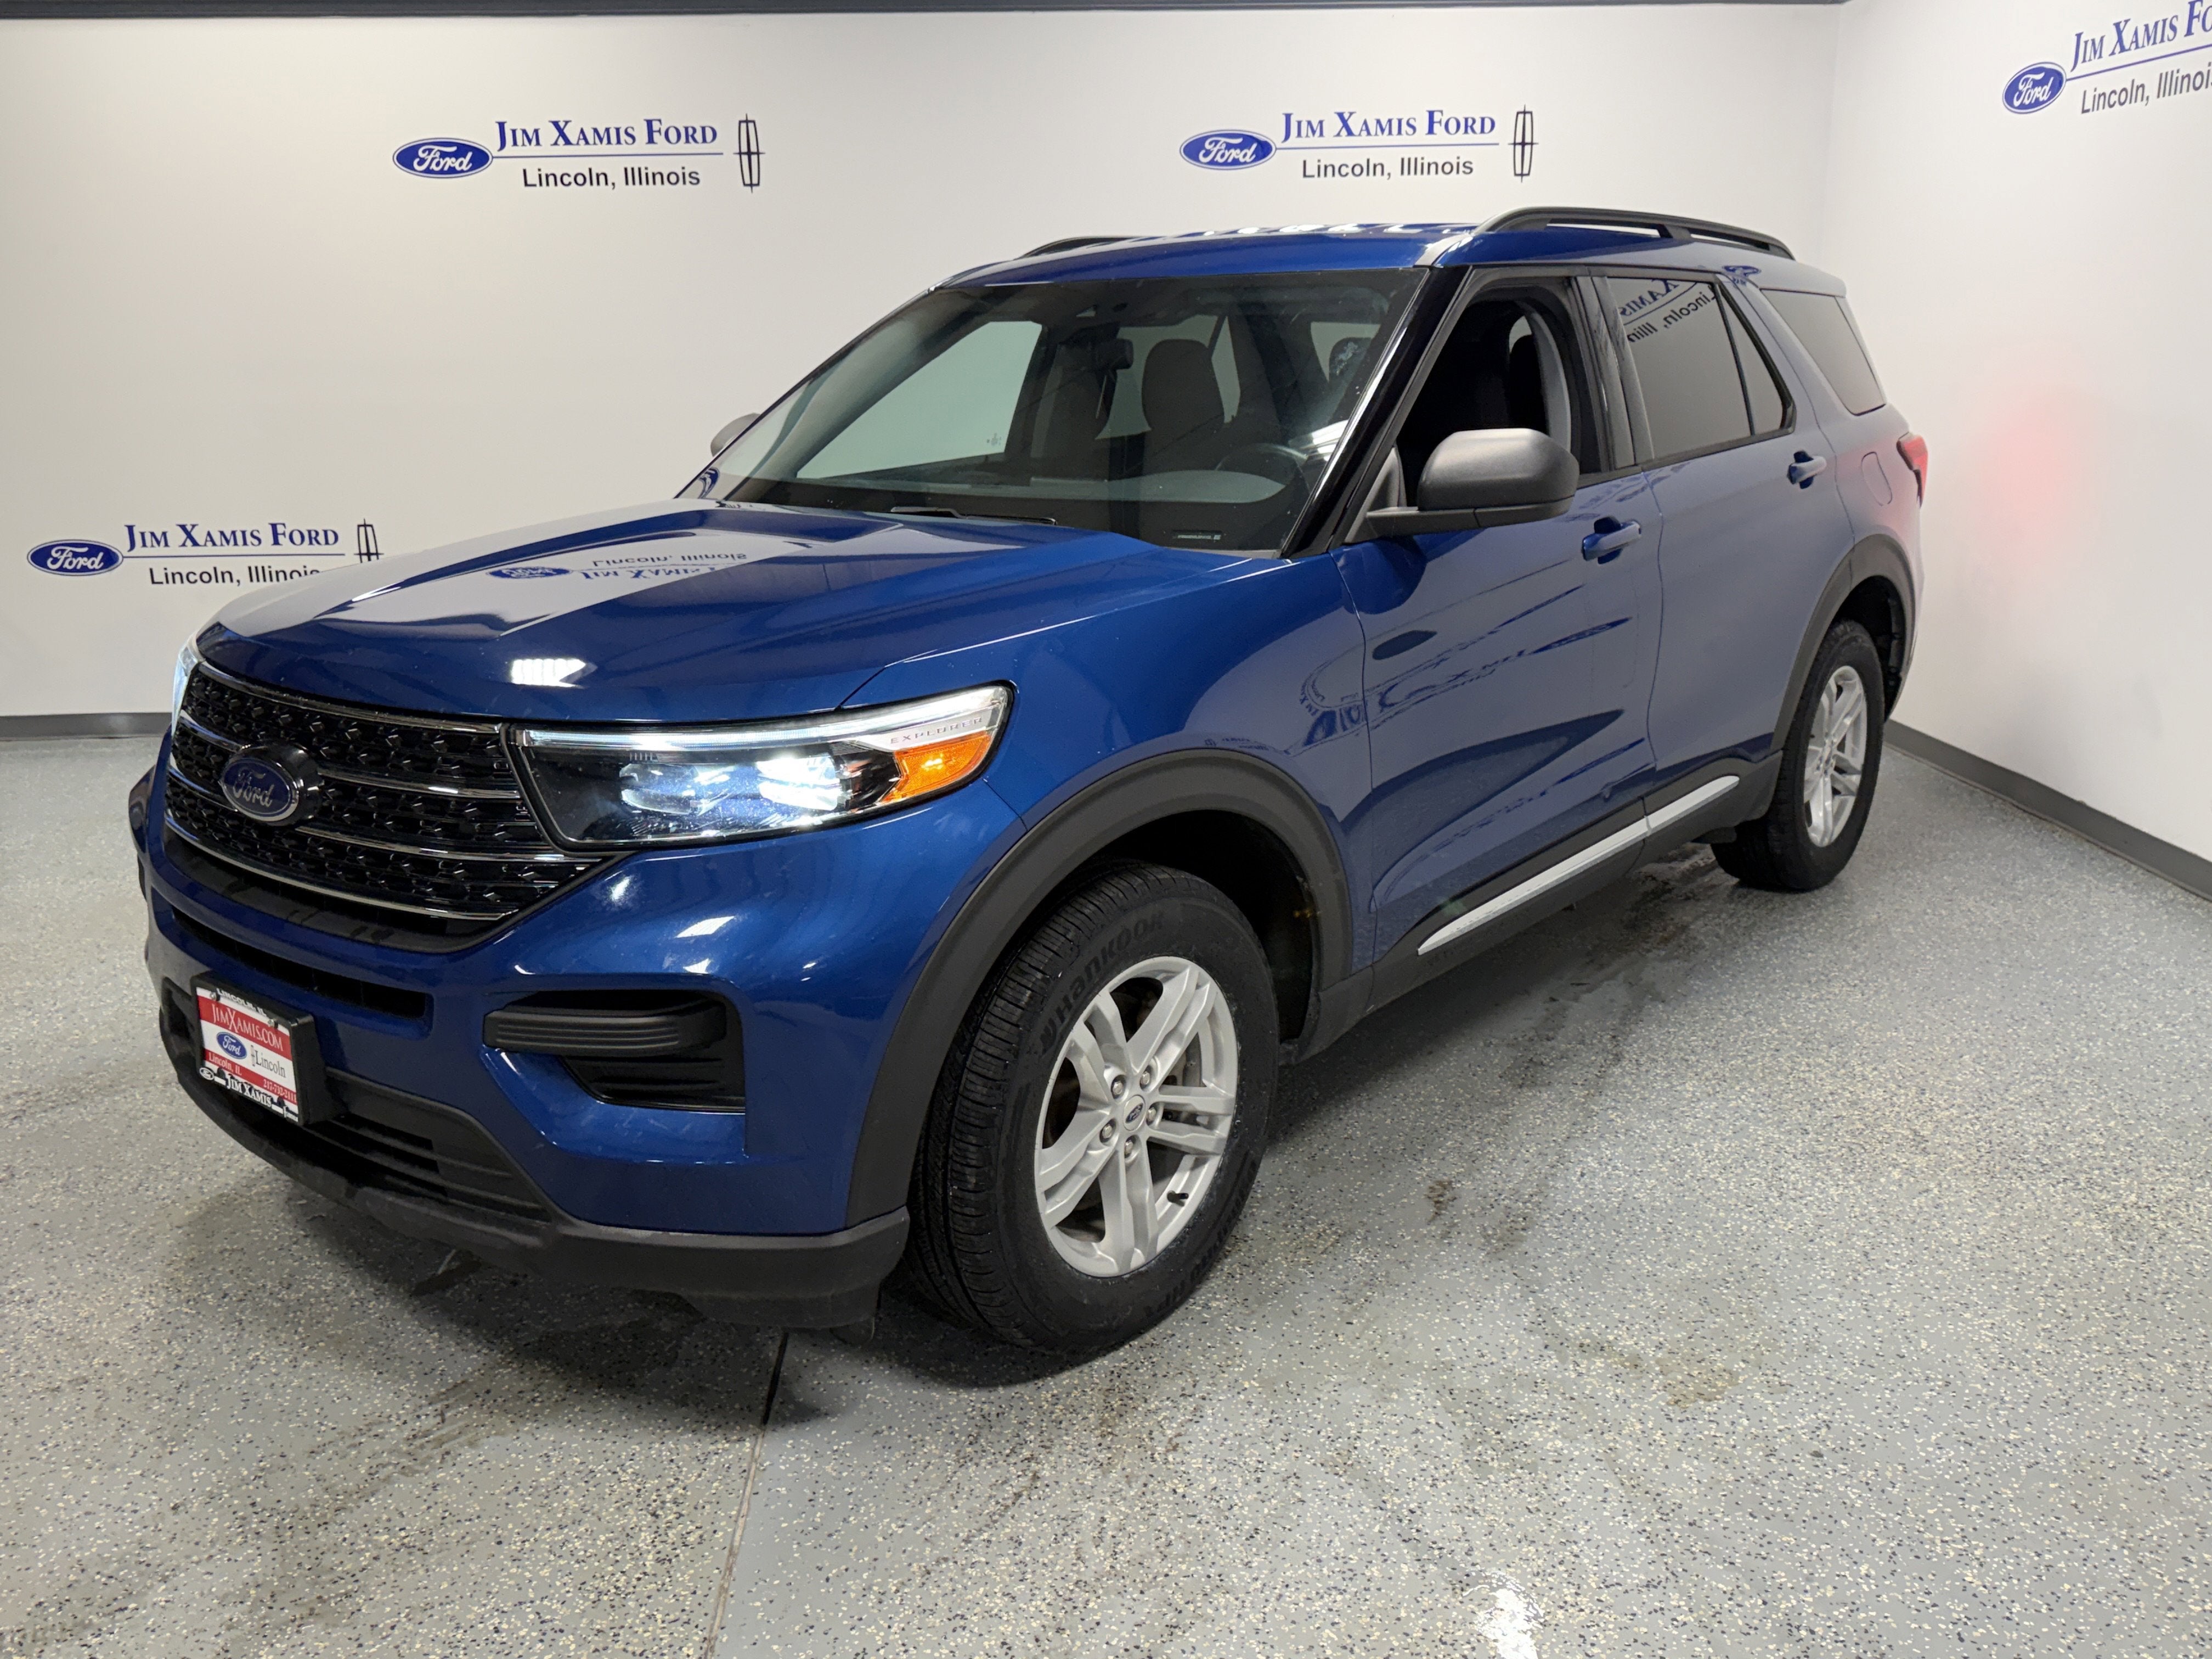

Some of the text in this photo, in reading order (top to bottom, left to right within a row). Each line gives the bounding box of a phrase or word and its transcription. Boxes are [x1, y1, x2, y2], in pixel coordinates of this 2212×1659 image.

[2070, 32, 2106, 72] JIM
[2108, 15, 2179, 57] XAMIS
[2013, 71, 2052, 108] Ford
[2081, 61, 2212, 114] Lincoln, Illinoi
[495, 118, 718, 151] JIM XAMIS FORD
[1281, 109, 1496, 143] JIM XAMIS FORD
[413, 144, 473, 172] Ford
[1198, 137, 1258, 163] Ford
[523, 166, 701, 190] Lincoln, Illinois
[1302, 156, 1474, 180] Lincoln, Illinois
[124, 522, 339, 552] JIM XAMIS FORD
[46, 545, 104, 570] Ford
[149, 566, 240, 586] Lincoln,
[890, 716, 983, 744] EXPLORER
[233, 769, 274, 808] Ford
[211, 1003, 284, 1052] JIMXAMIS.COM
[222, 1035, 241, 1056] Ford
[255, 1050, 286, 1079] Lincoln
[227, 1075, 272, 1108] JIM XAMIS
